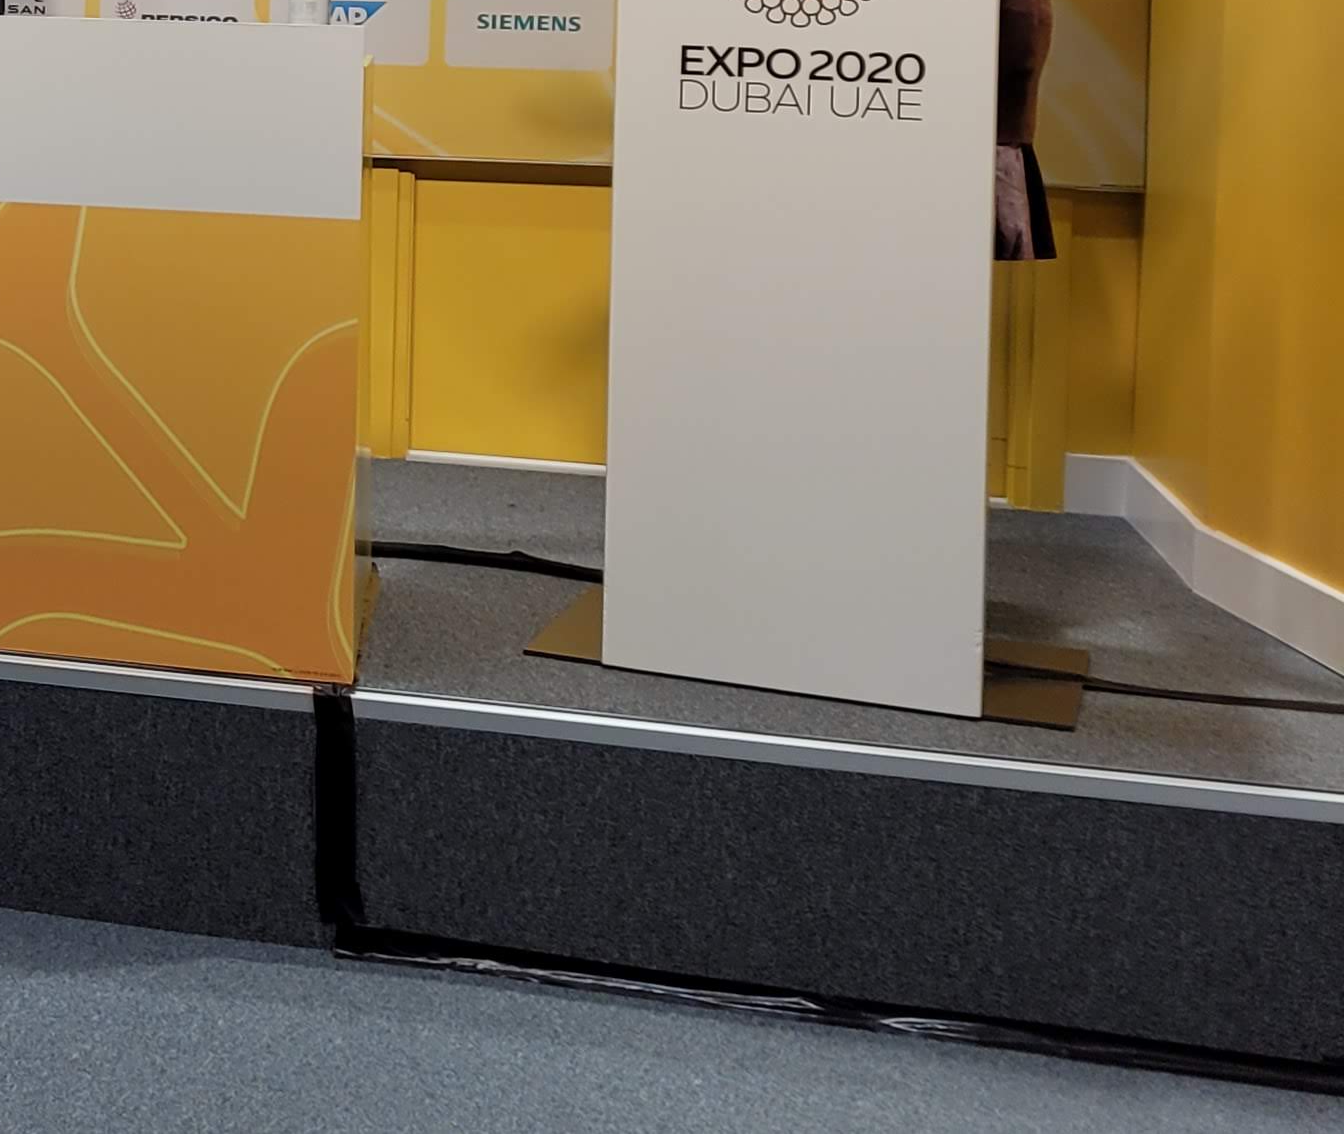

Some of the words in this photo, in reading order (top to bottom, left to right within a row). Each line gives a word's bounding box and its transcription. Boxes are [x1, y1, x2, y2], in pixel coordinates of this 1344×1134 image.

[478, 14, 580, 31] SIEMENS
[681, 46, 800, 79] EXPO
[809, 50, 925, 84] 2020
[680, 79, 810, 115] DUBAI
[831, 86, 922, 120] UAE
